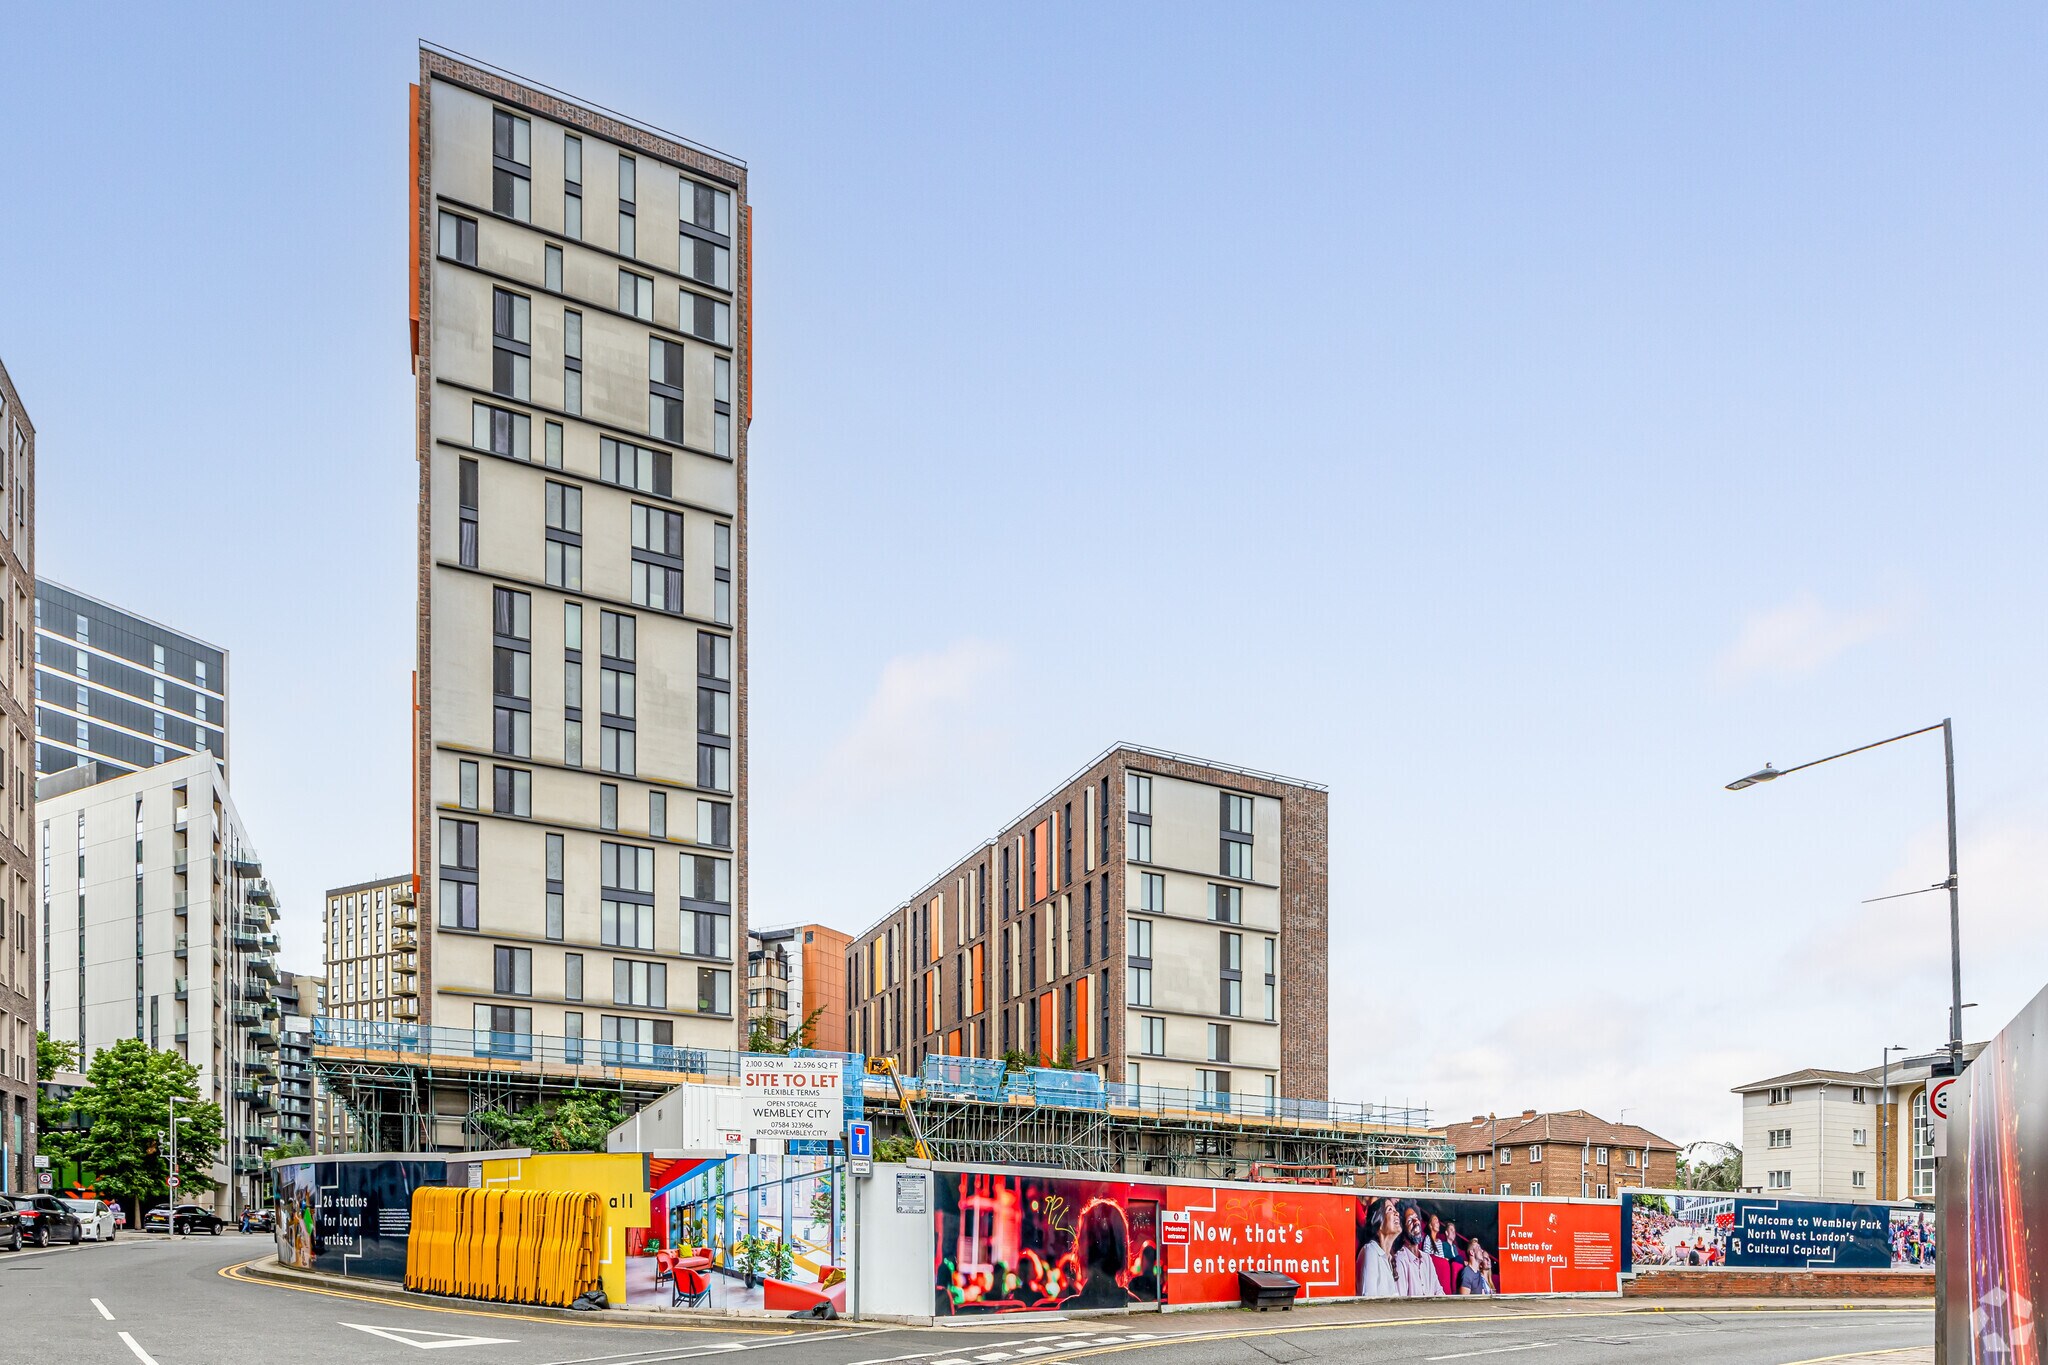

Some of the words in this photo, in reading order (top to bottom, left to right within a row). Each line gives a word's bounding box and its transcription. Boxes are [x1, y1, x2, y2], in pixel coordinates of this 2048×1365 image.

[764, 1060, 774, 1069] SQ
[817, 1061, 828, 1070] SQ
[746, 1073, 779, 1087] SITE
[783, 1074, 807, 1087] TO
[811, 1075, 838, 1088] LET
[763, 1088, 795, 1096] FLEXIBLE
[753, 1108, 804, 1118] WEMBLEY
[806, 1109, 831, 1119] CITY
[770, 1121, 790, 1129] 07584
[323, 1195, 333, 1208] 26
[335, 1194, 368, 1208] studios
[609, 1193, 633, 1209] all
[324, 1214, 336, 1227] for
[339, 1213, 362, 1227] local
[1748, 1213, 1794, 1226] Welcome
[1797, 1217, 1809, 1227] to
[1812, 1216, 1857, 1230] Wembley
[1860, 1218, 1882, 1230] Park
[1165, 1225, 1188, 1233] Pedestrian
[1193, 1220, 1237, 1245] Now,
[1245, 1222, 1304, 1244] that's
[1510, 1229, 1516, 1238] A
[1747, 1228, 1776, 1241] North
[1780, 1229, 1807, 1241] West
[1809, 1230, 1855, 1242] London's
[324, 1233, 353, 1246] artists
[1510, 1242, 1540, 1251] theatre
[1541, 1242, 1552, 1250] for
[1747, 1242, 1789, 1255] Cultural
[1793, 1245, 1831, 1257] Capital
[1193, 1253, 1330, 1273] entertainment
[1510, 1253, 1545, 1264] Wembley
[1546, 1254, 1564, 1263] Park
